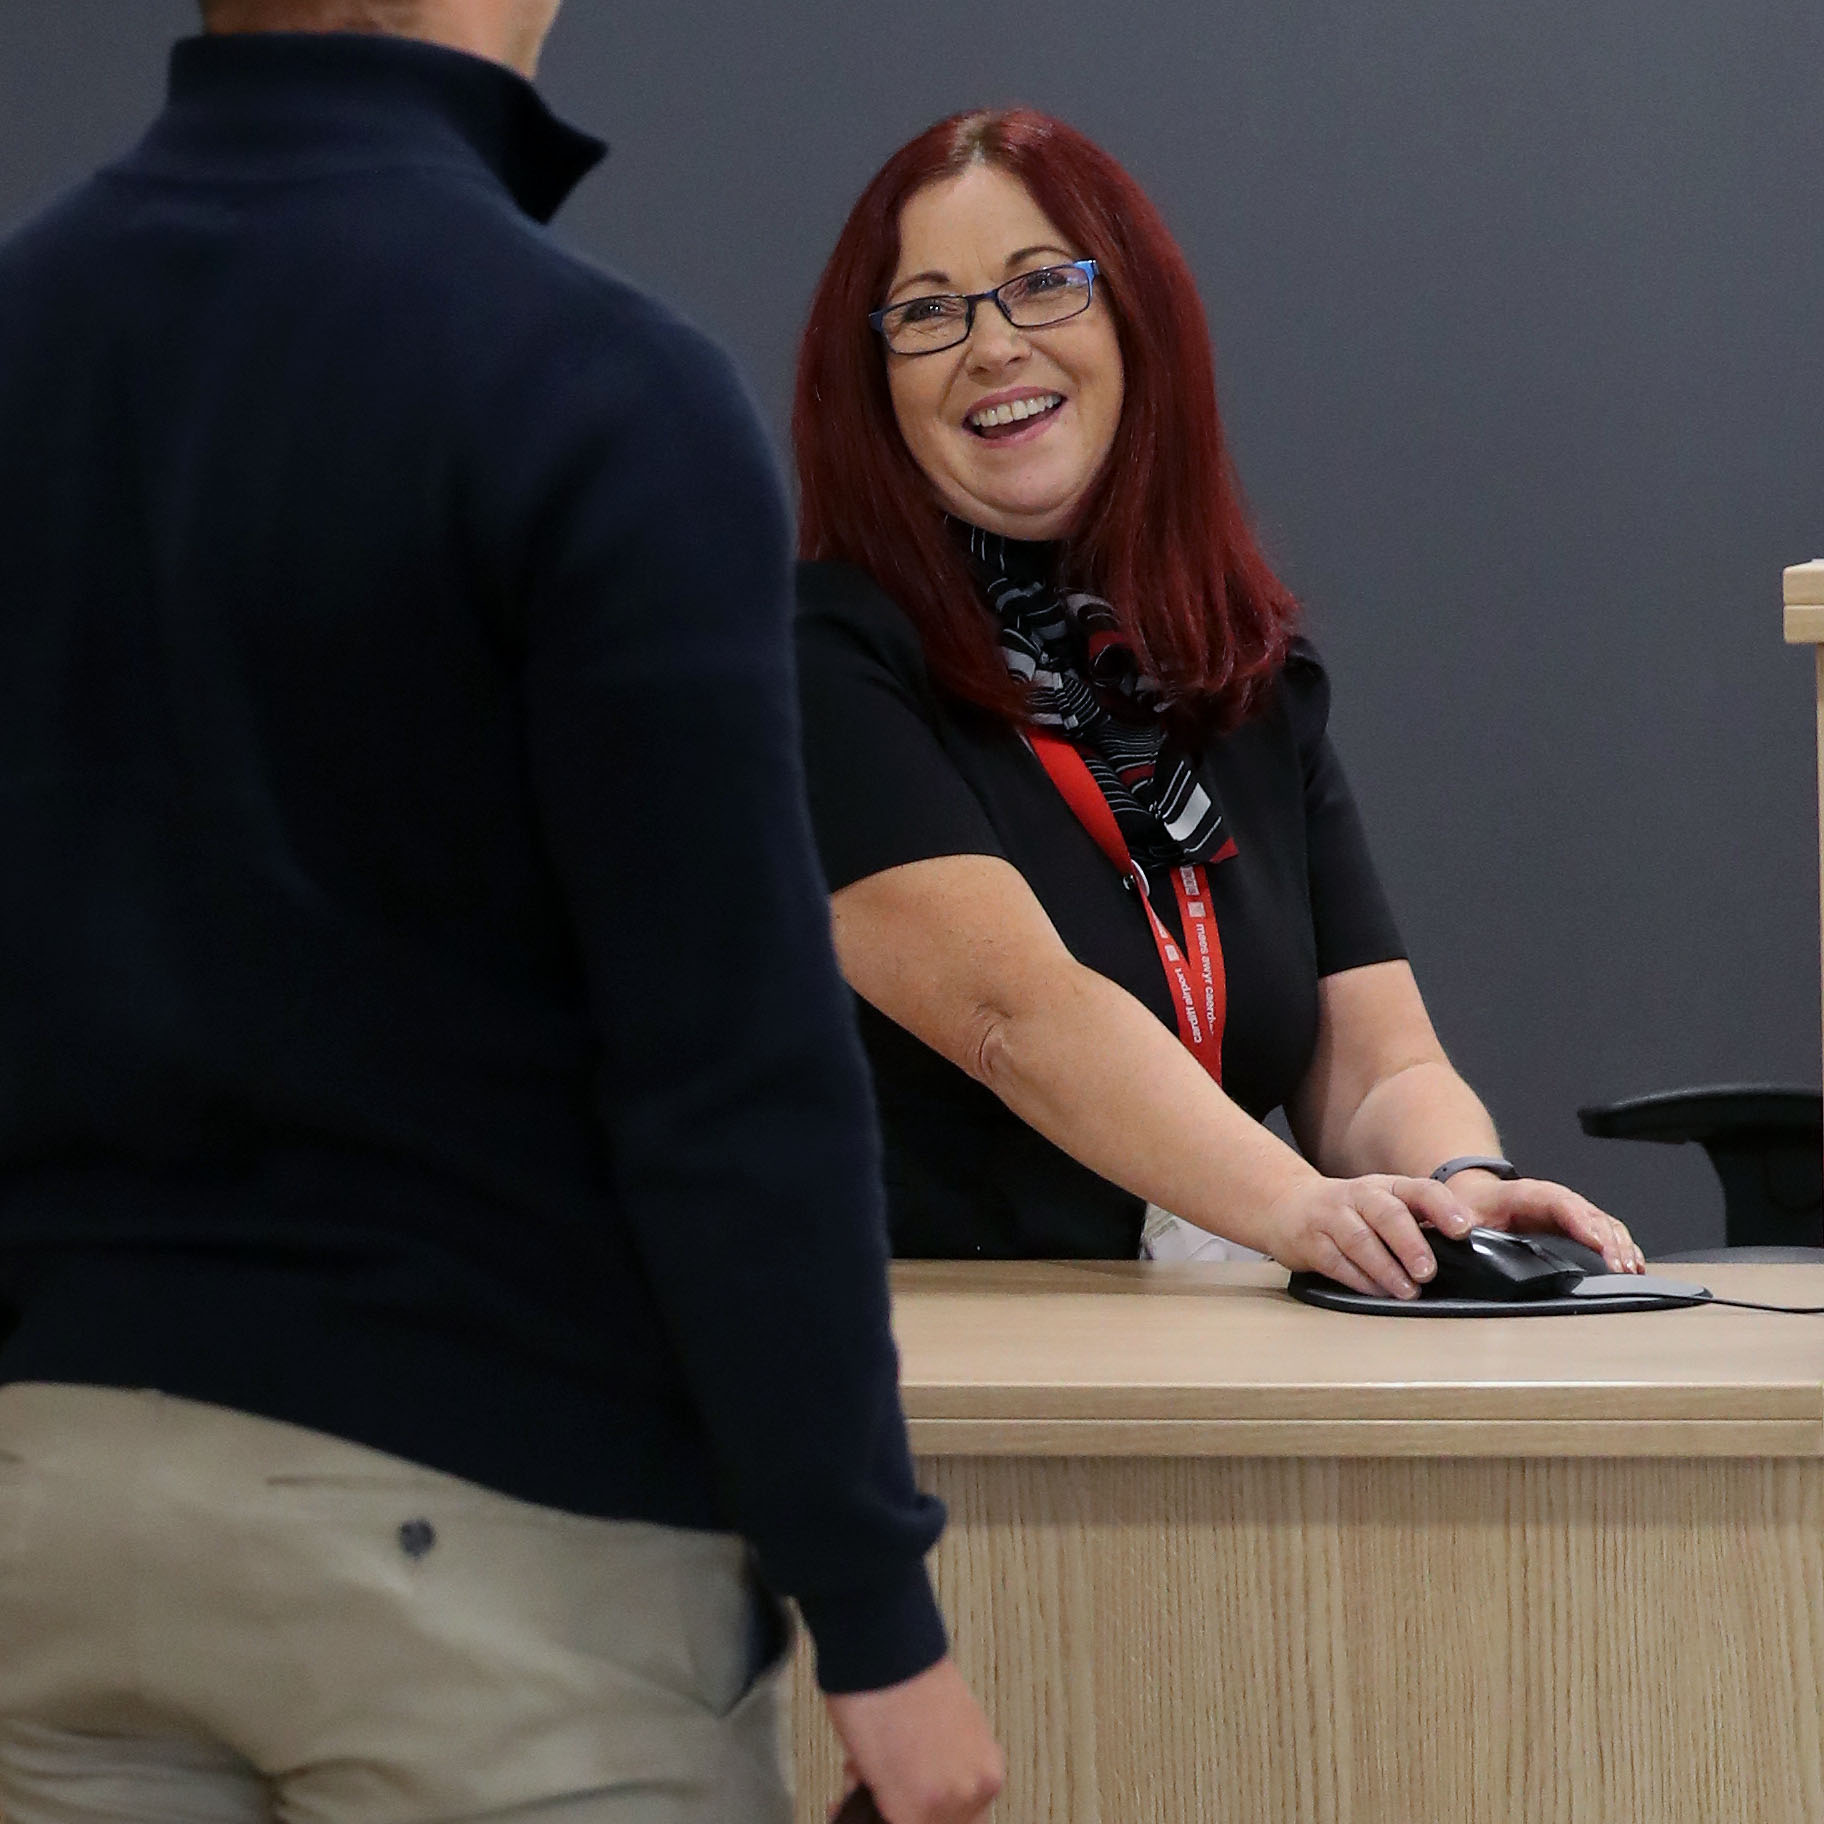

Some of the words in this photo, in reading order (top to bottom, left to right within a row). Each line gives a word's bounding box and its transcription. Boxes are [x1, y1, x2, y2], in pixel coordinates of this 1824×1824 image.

[1196, 923, 1210, 955] maes
[1175, 968, 1194, 1005] airport
[1201, 956, 1214, 984] awyr
[1186, 1005, 1203, 1043] cardiff
